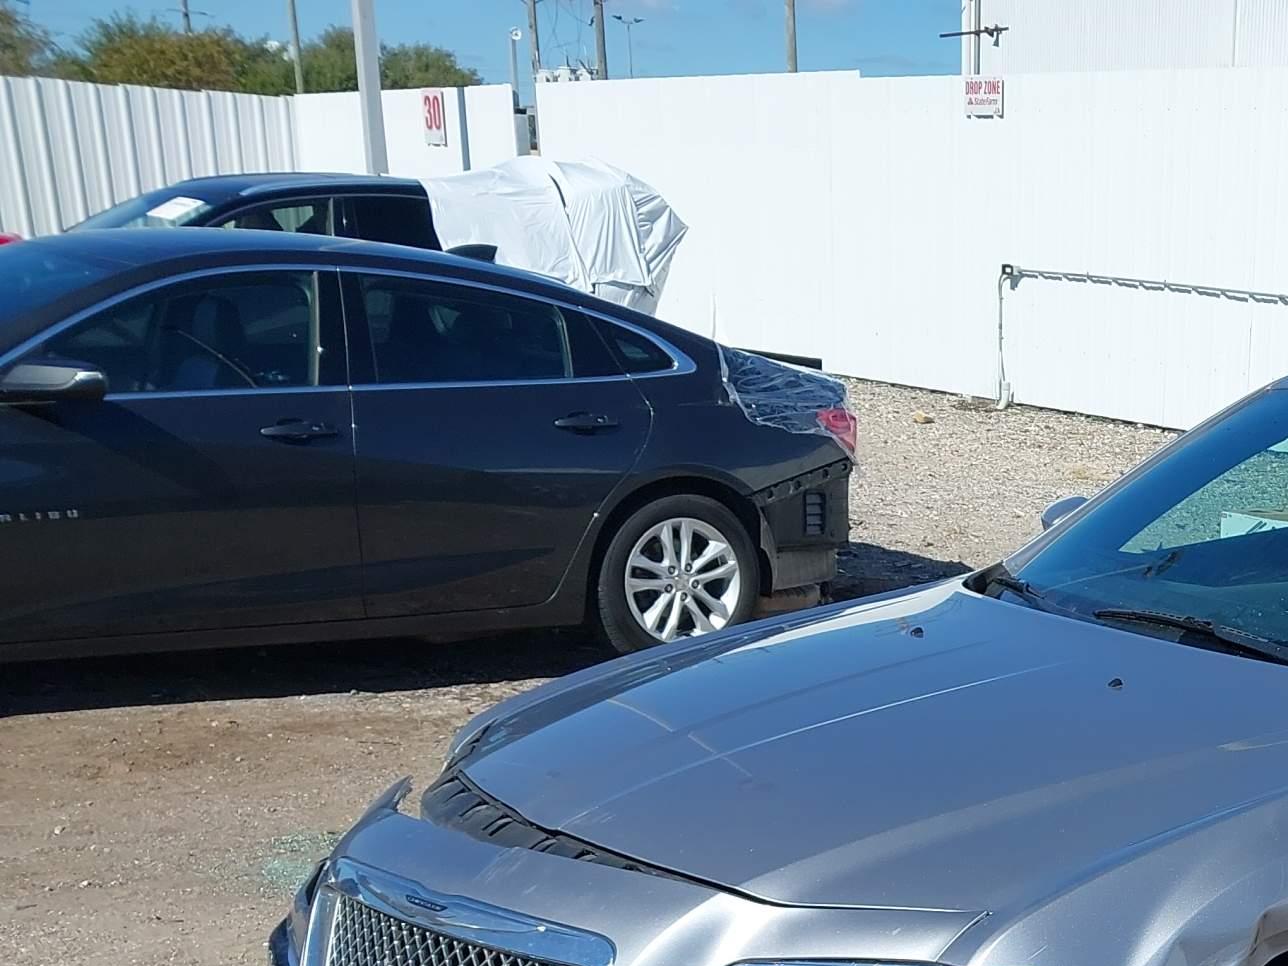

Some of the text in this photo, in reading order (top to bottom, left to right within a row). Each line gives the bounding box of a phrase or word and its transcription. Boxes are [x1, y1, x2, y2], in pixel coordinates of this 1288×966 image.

[965, 80, 1001, 95] DROP ZONE
[424, 95, 442, 130] 30
